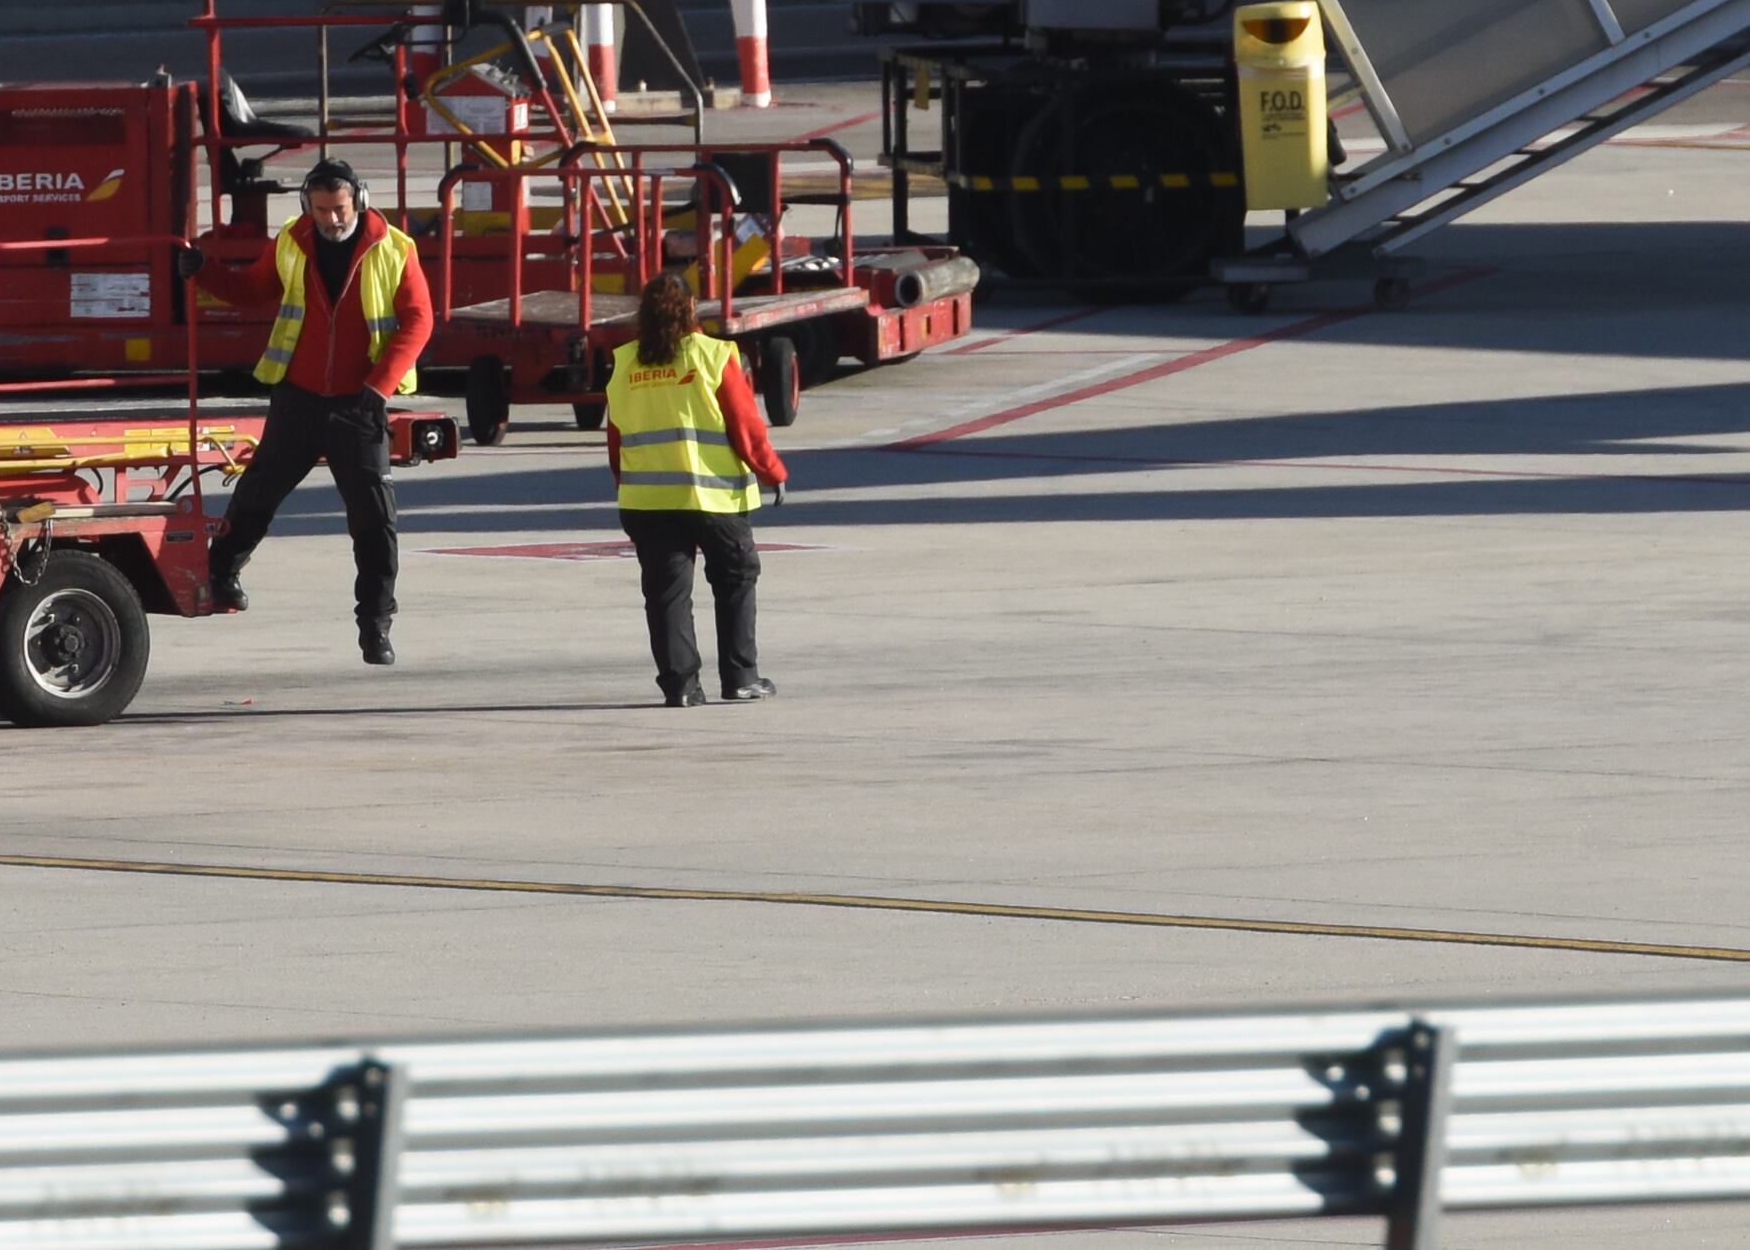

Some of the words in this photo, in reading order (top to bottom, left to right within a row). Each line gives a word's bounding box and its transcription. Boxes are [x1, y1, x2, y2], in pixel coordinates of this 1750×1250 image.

[1260, 90, 1306, 112] F.O.D.
[32, 193, 81, 202] SERVICES
[629, 368, 677, 384] IBERIA
